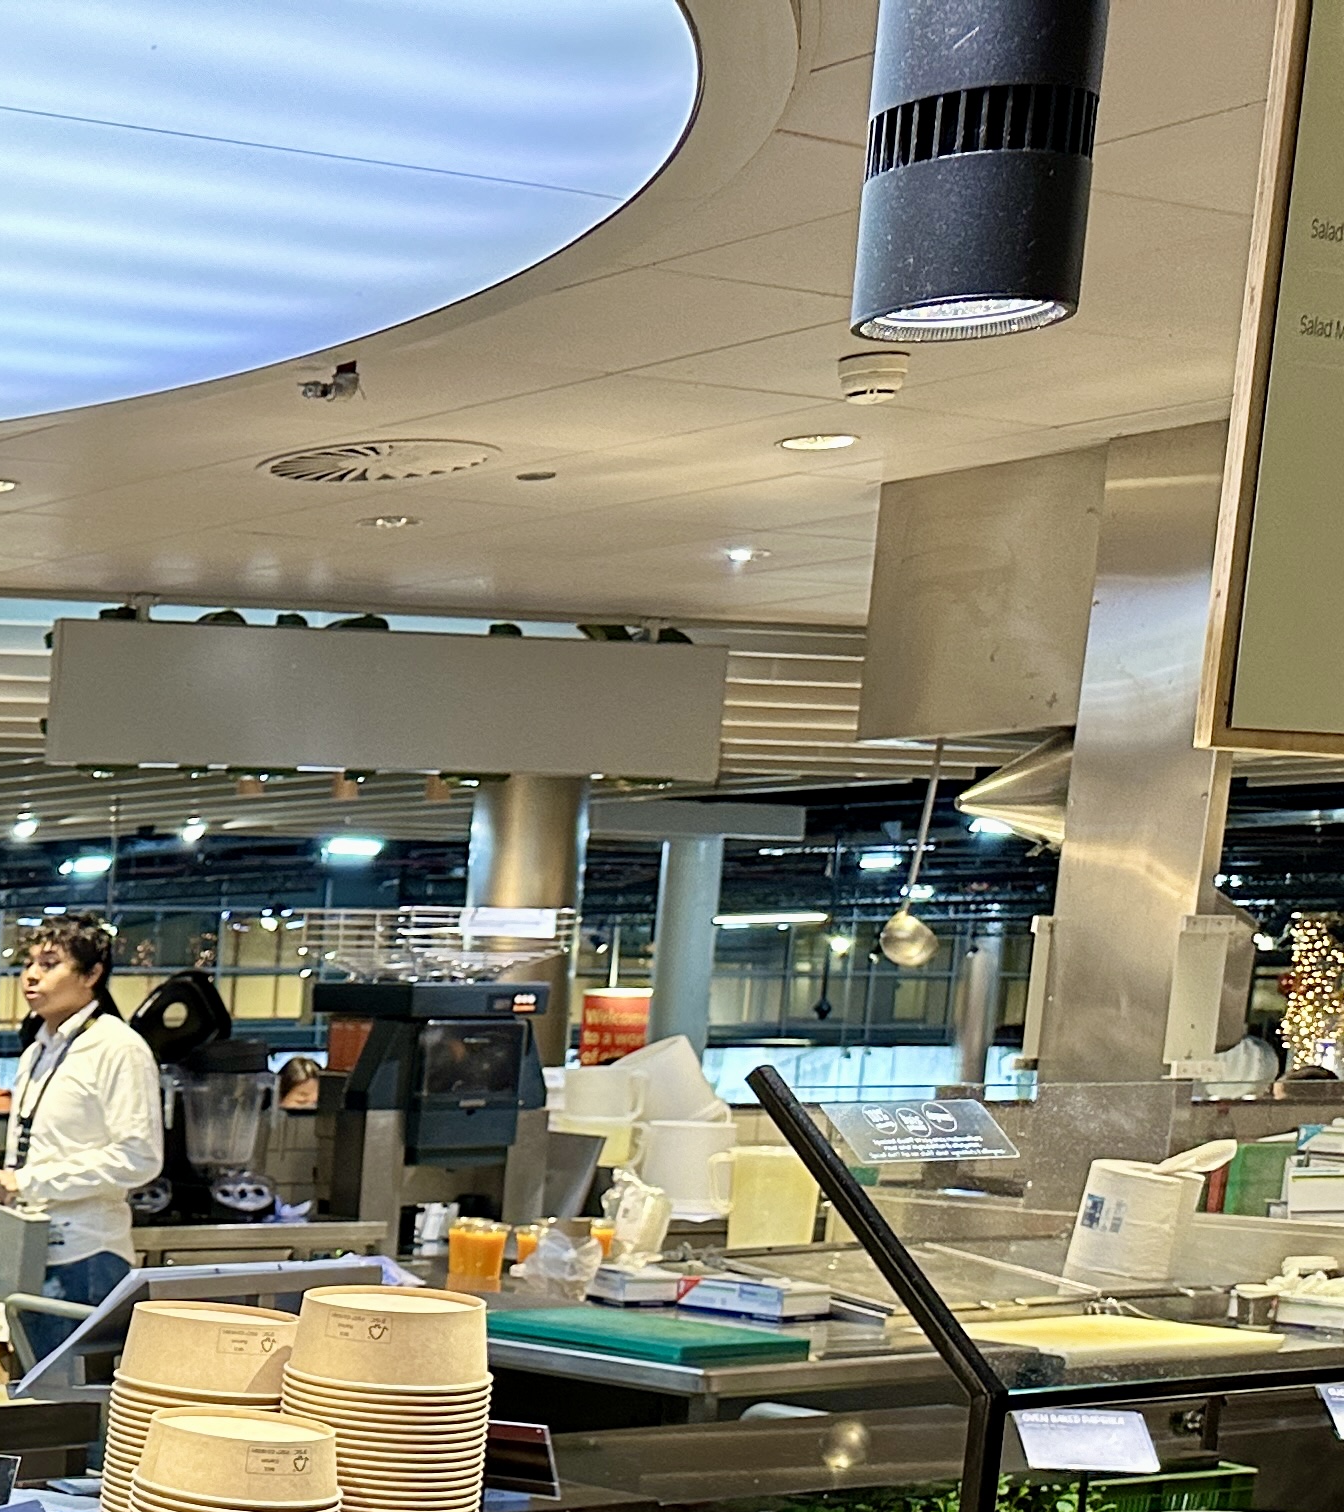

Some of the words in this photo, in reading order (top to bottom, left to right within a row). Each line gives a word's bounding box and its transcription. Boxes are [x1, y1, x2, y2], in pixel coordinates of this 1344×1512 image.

[1299, 314, 1333, 337] Salad
[614, 1033, 645, 1046] wor
[1022, 1413, 1048, 1422] OVEN
